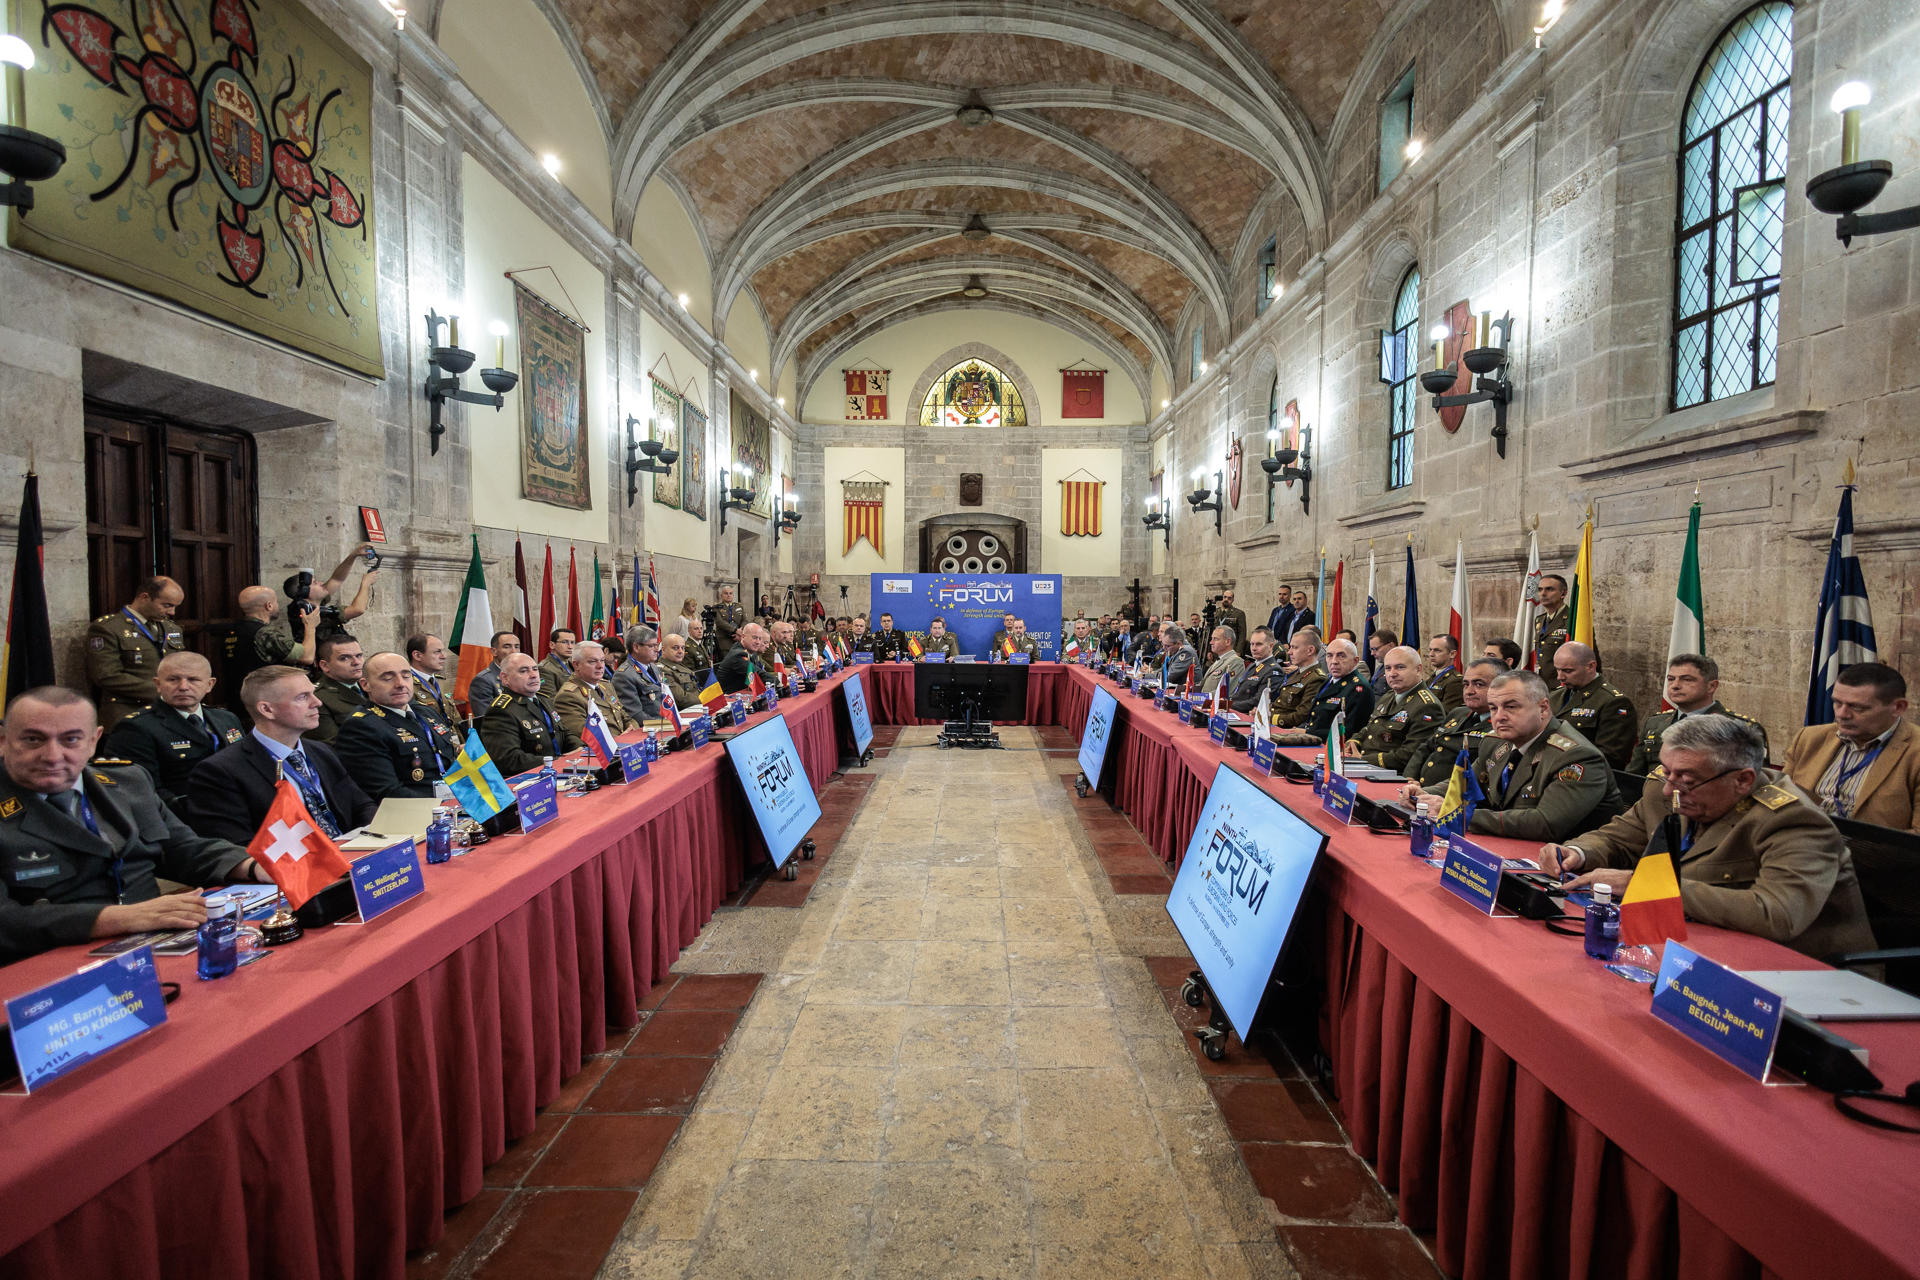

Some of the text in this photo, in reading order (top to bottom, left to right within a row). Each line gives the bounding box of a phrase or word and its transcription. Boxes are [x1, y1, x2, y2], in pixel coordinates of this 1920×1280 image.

[939, 588, 1013, 605] FORUM
[757, 755, 794, 798] FORUM
[1222, 822, 1237, 840] NINTH
[372, 876, 409, 899] SWITZERLAND
[1206, 829, 1269, 916] FORUM
[1445, 866, 1492, 899] BOSNIA AND HERZEGOVINA
[44, 999, 144, 1055] UNITED KINGDOM
[47, 990, 134, 1036] MG. Barry, Chris
[1665, 976, 1764, 1040] MG. Baugnée, Jean-Pol
[1688, 1004, 1730, 1036] BELGIUM
